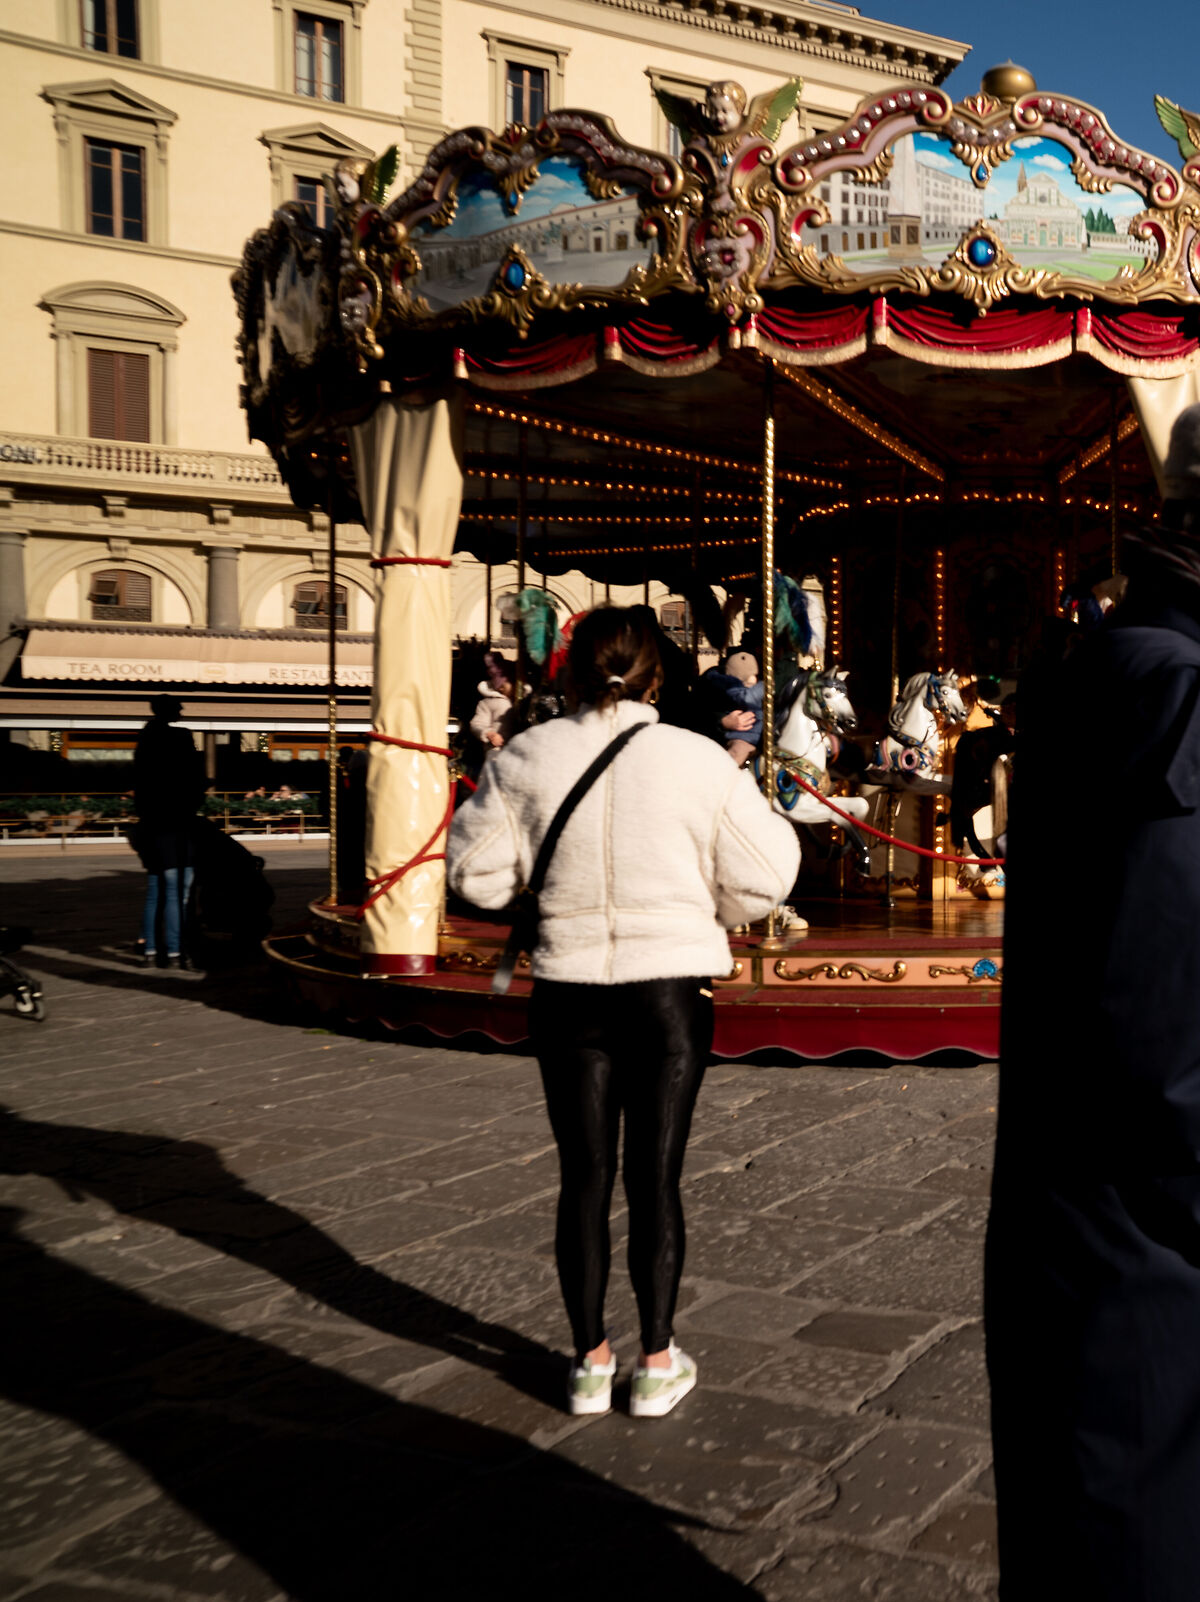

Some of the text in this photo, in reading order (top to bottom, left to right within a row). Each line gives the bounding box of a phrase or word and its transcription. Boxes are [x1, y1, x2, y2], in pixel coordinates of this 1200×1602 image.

[67, 662, 163, 675] TEA ROOM
[268, 668, 374, 681] RESTAUANT
